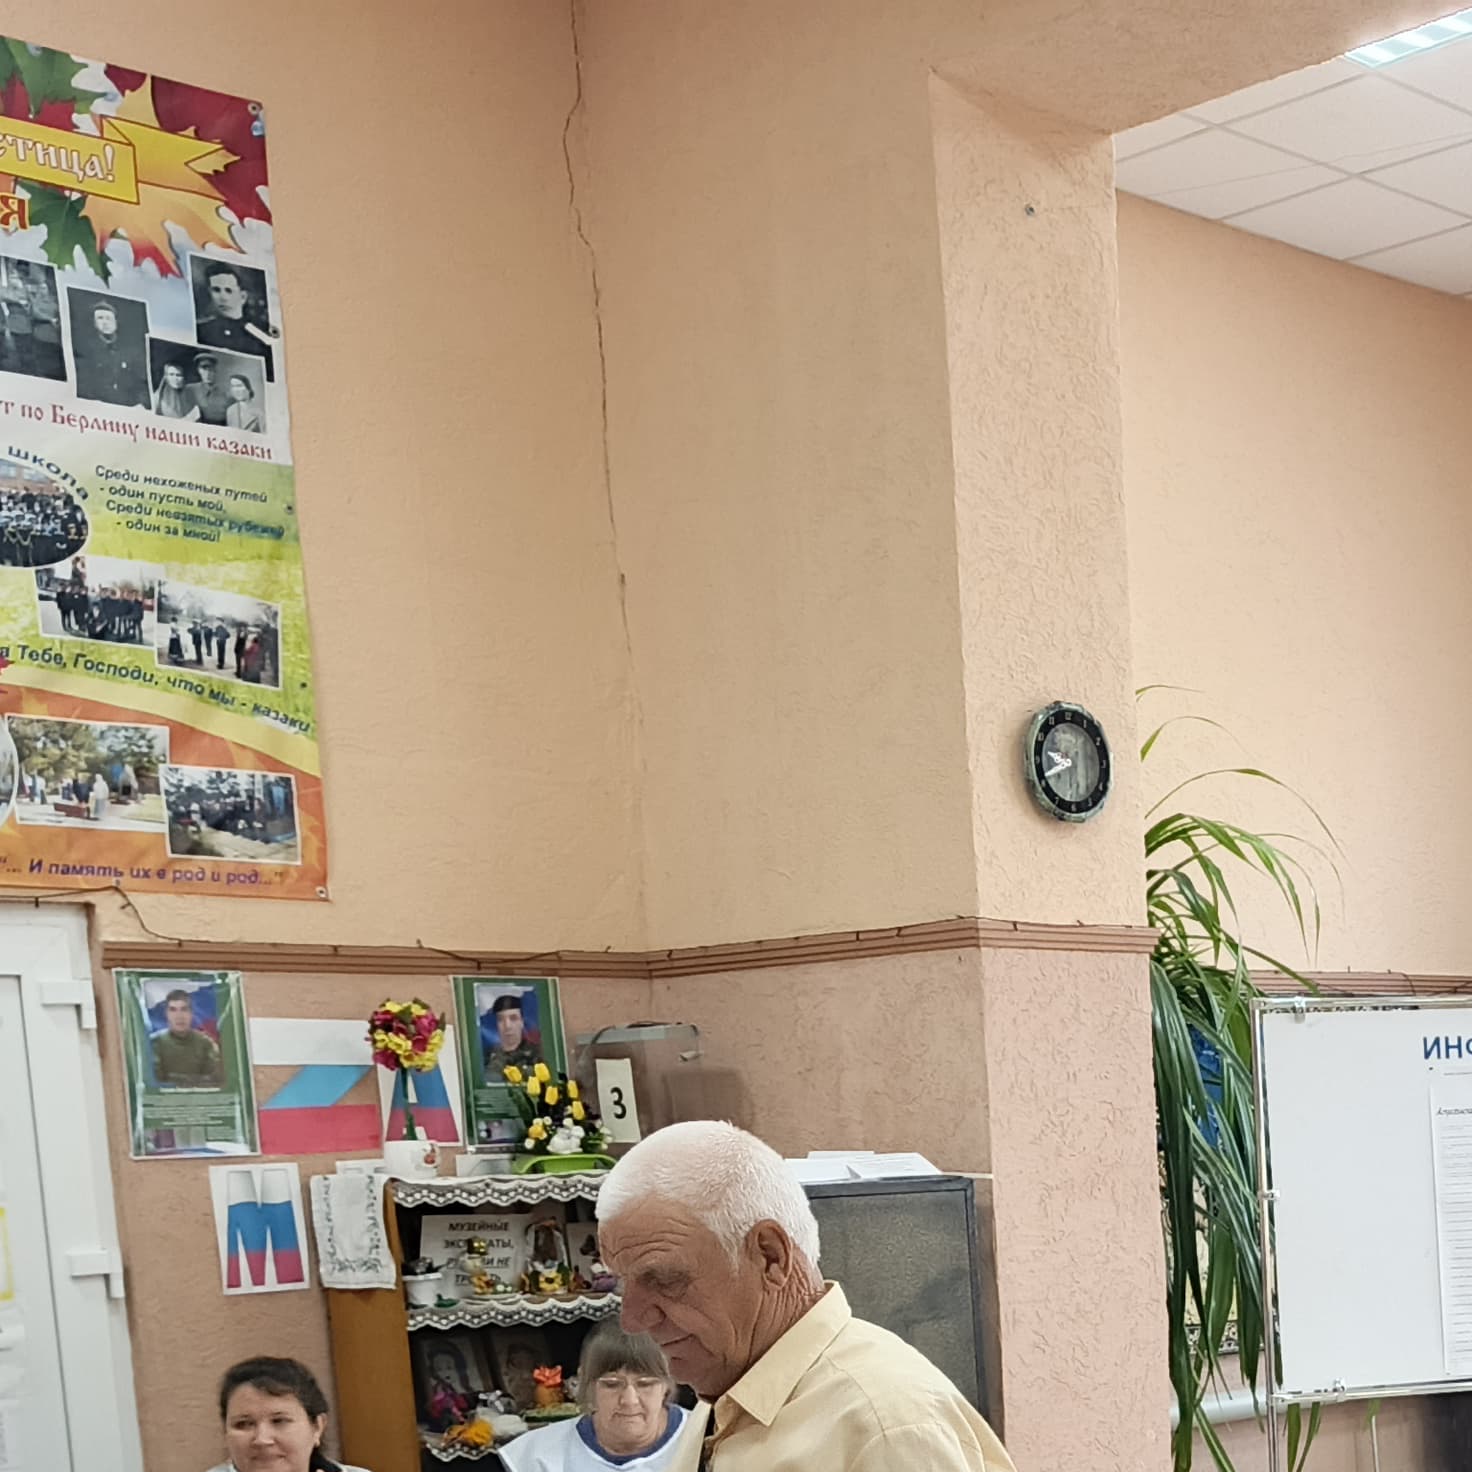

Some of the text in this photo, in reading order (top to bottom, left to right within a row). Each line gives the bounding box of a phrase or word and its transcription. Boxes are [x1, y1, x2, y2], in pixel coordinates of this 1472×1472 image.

[21, 404, 43, 421] по
[52, 404, 139, 442] Берлину
[145, 426, 199, 447] наши
[207, 436, 272, 460] казаки
[95, 464, 267, 504] Среди нехоженых путей
[108, 485, 145, 499] один
[149, 491, 194, 507] пусть
[106, 500, 152, 516] Среди
[126, 519, 160, 533] один
[165, 526, 179, 536] за
[18, 644, 67, 669] Тебе,
[167, 675, 205, 696] что
[208, 689, 235, 706] мы
[28, 859, 43, 873] И
[48, 863, 124, 878] память
[130, 867, 151, 879] их
[156, 869, 166, 880] в
[172, 867, 206, 883] род
[211, 872, 221, 882] и
[610, 1087, 627, 1119] 3
[444, 1239, 514, 1248] ЭКСАТЫ,
